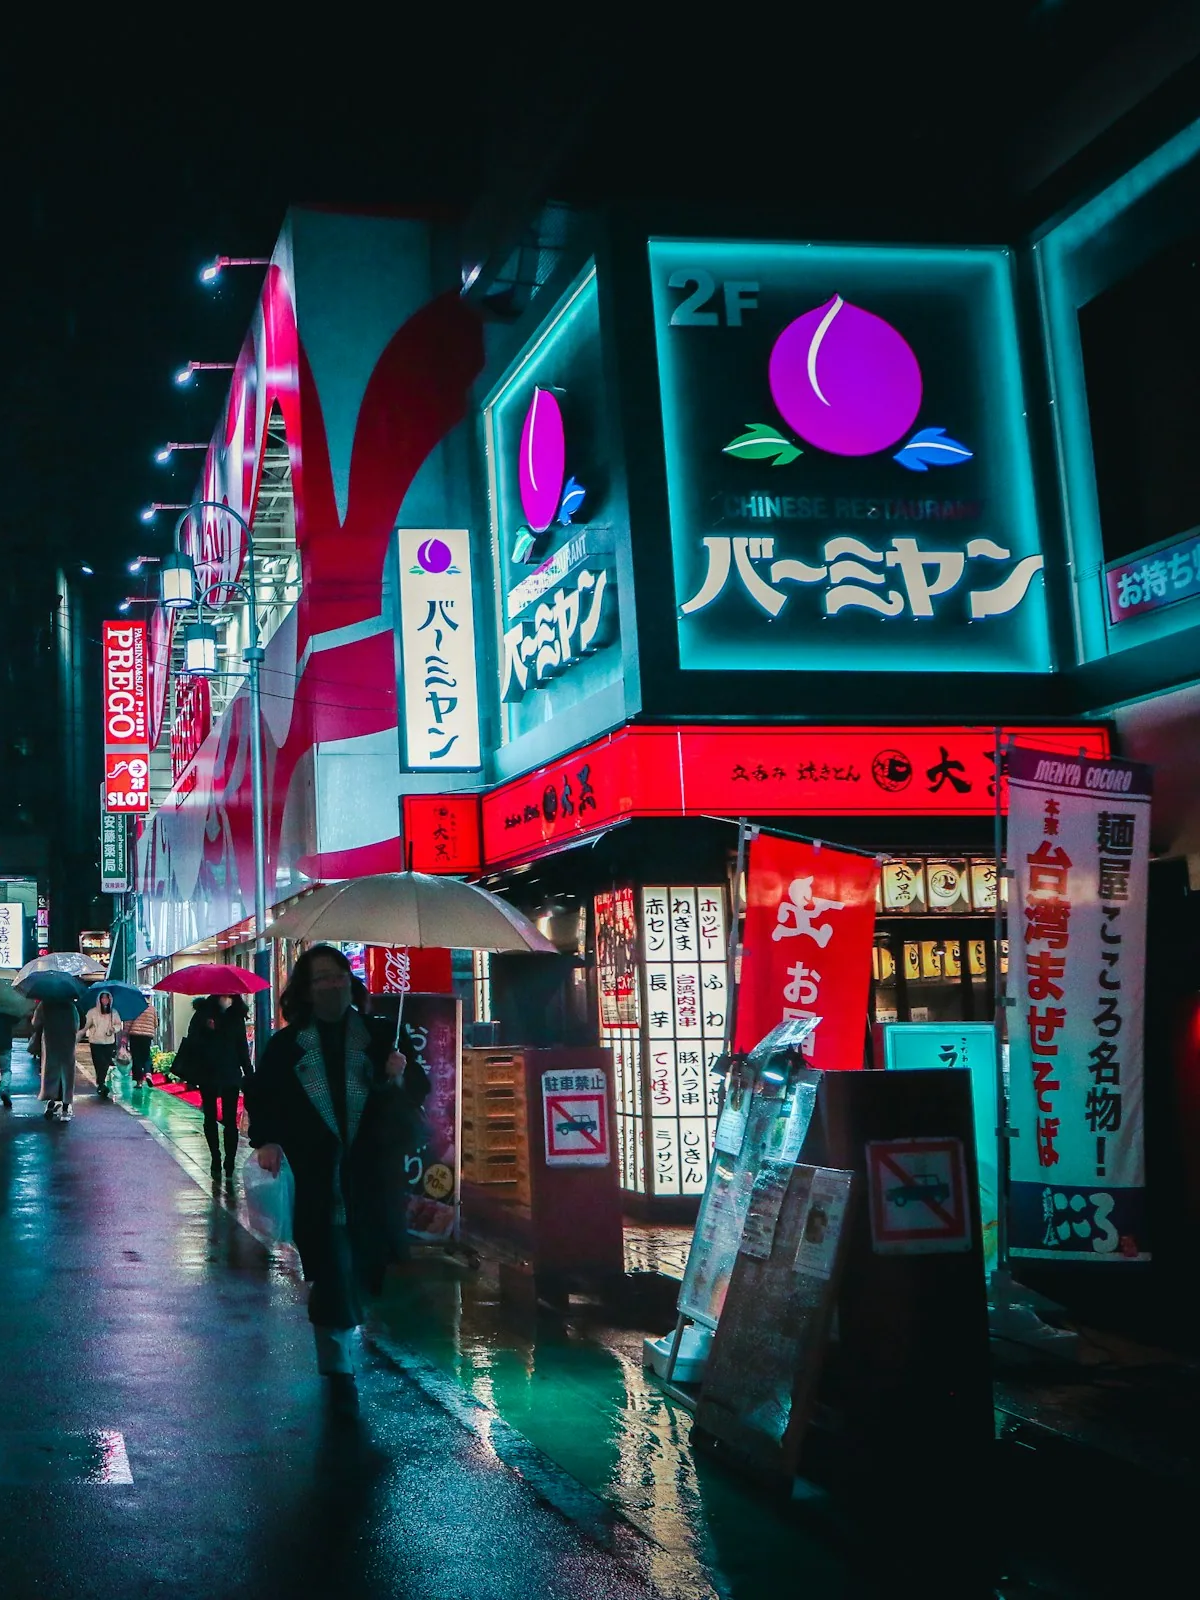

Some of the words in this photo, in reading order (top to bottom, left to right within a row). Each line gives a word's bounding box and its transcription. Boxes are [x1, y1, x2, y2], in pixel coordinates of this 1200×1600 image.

[667, 269, 760, 328] 2F
[726, 495, 829, 520] CHINESE
[835, 497, 980, 521] RESTAURA
[681, 536, 1044, 619] バーミヤン
[107, 627, 136, 738] PREGO
[417, 600, 460, 761] バーミヤン
[130, 777, 146, 790] 2F
[796, 761, 861, 782] 焼きとん
[1034, 758, 1082, 785] MENYA
[1085, 765, 1132, 792] COCORO
[107, 791, 148, 807] SLOT
[1044, 798, 1060, 835] 本家
[103, 815, 117, 873] 安藤薬局
[117, 834, 125, 873] pharmacy
[894, 866, 912, 901] 大黒
[645, 898, 666, 951] 赤セン
[672, 898, 693, 952] ねぎま
[699, 898, 719, 950] ホッピー
[649, 973, 670, 1028] 長芋
[677, 973, 698, 1028] 台湾肉巻串
[703, 974, 725, 1028] ふわ
[1025, 840, 1072, 1168] 台湾まぜそば
[1085, 811, 1136, 1178] 麺屋こころ名物!
[544, 1074, 605, 1092] 駐車禁止
[650, 1052, 672, 1106] てっぽう
[678, 1050, 700, 1105] 豚バラ串
[655, 1129, 673, 1184] ミノサンド
[683, 1129, 704, 1183] しきん
